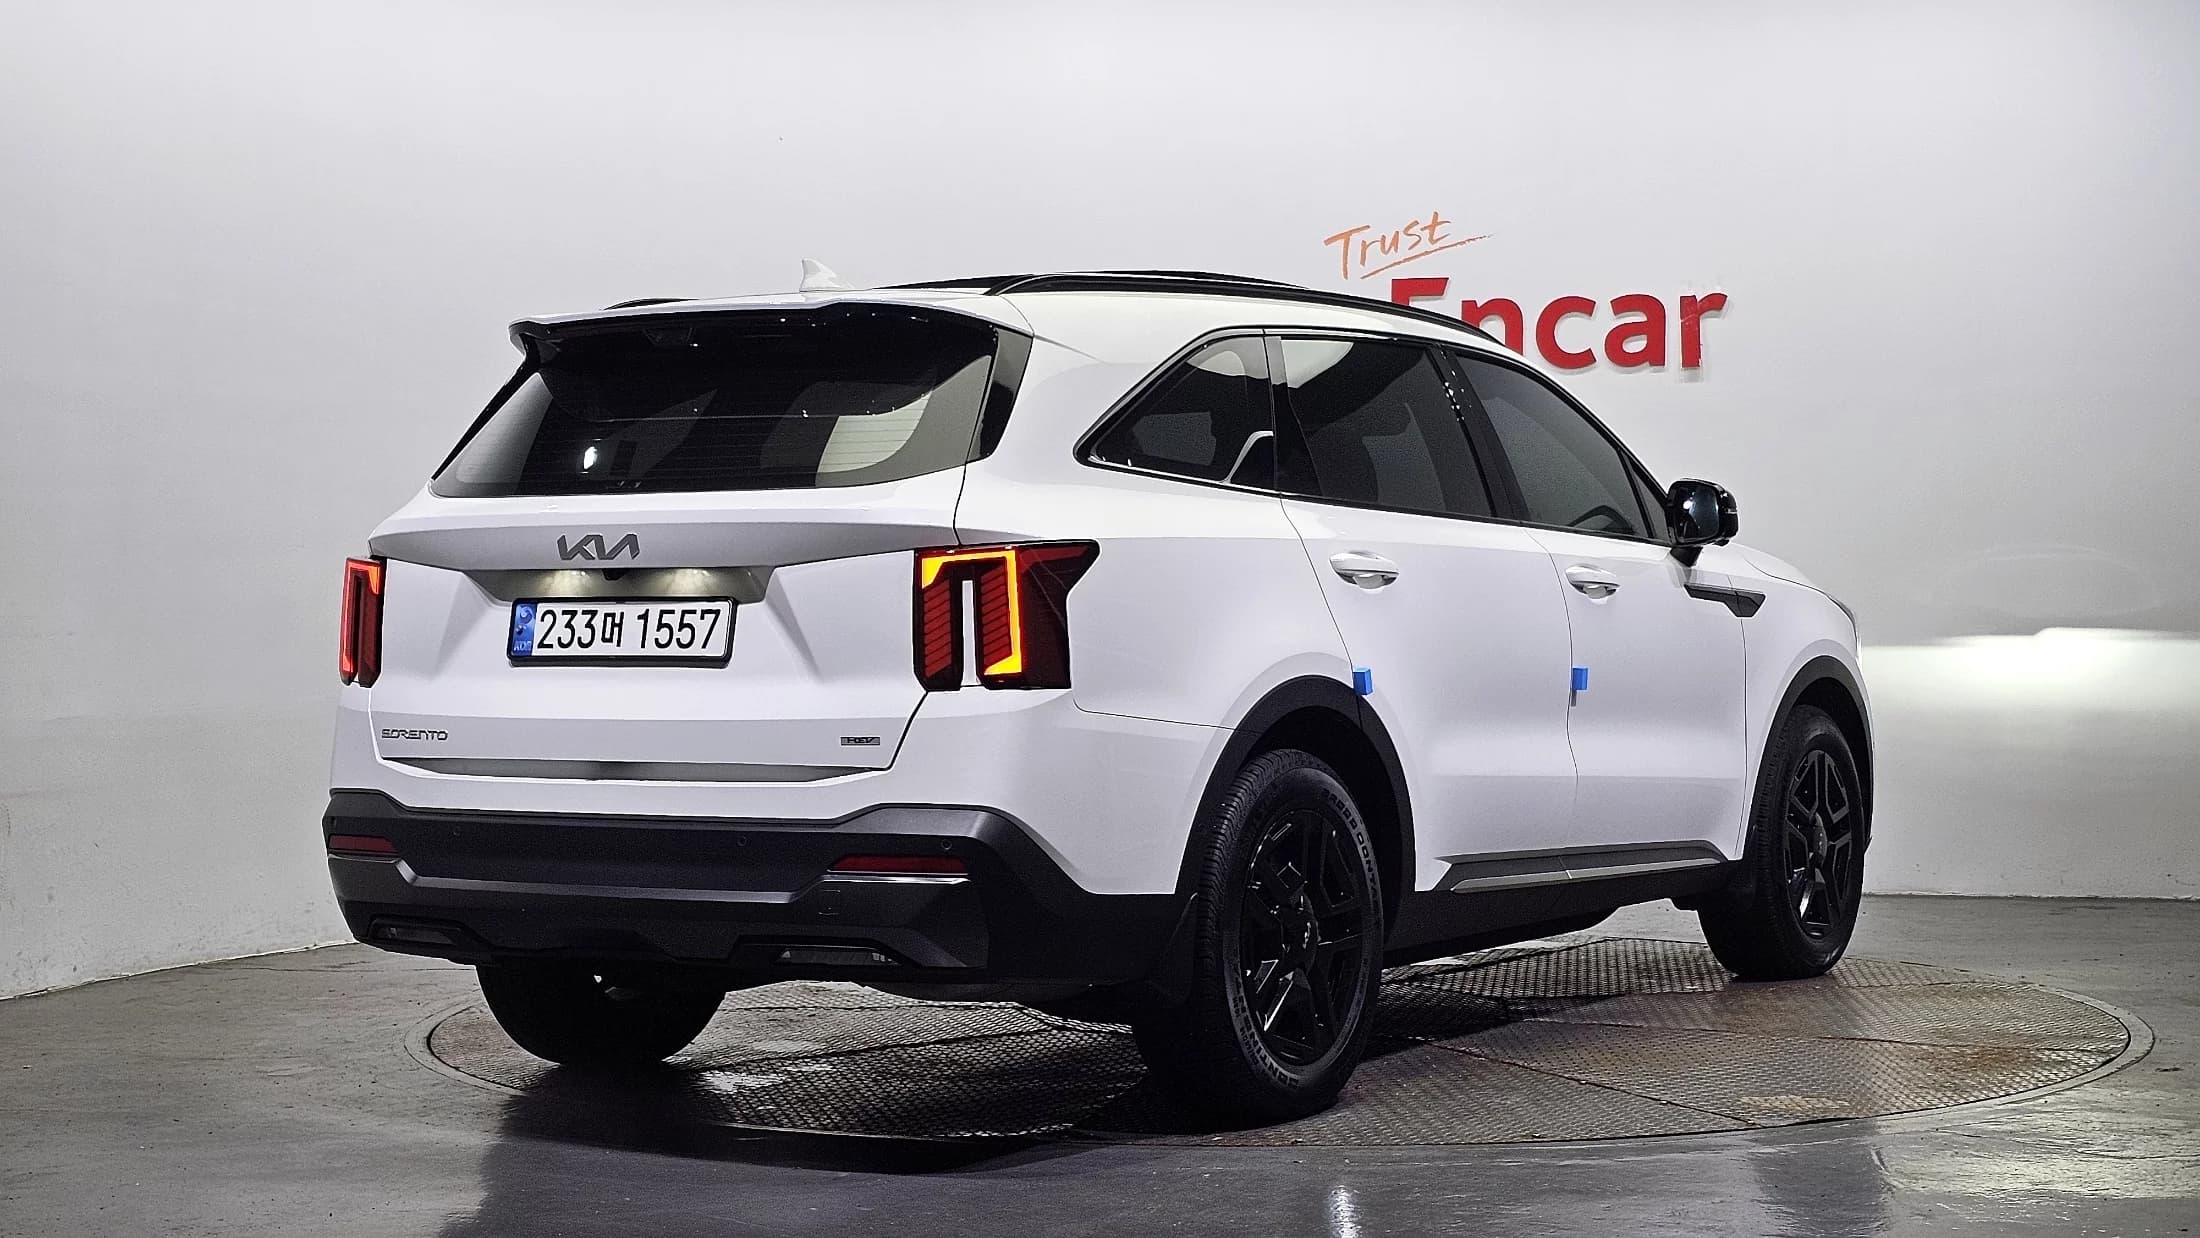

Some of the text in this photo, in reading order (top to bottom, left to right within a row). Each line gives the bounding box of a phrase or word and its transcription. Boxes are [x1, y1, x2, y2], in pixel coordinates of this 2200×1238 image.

[1323, 211, 1452, 280] Trust
[556, 533, 641, 561] KIA
[537, 608, 722, 650] 233머 1557
[381, 728, 449, 741] SORENTO
